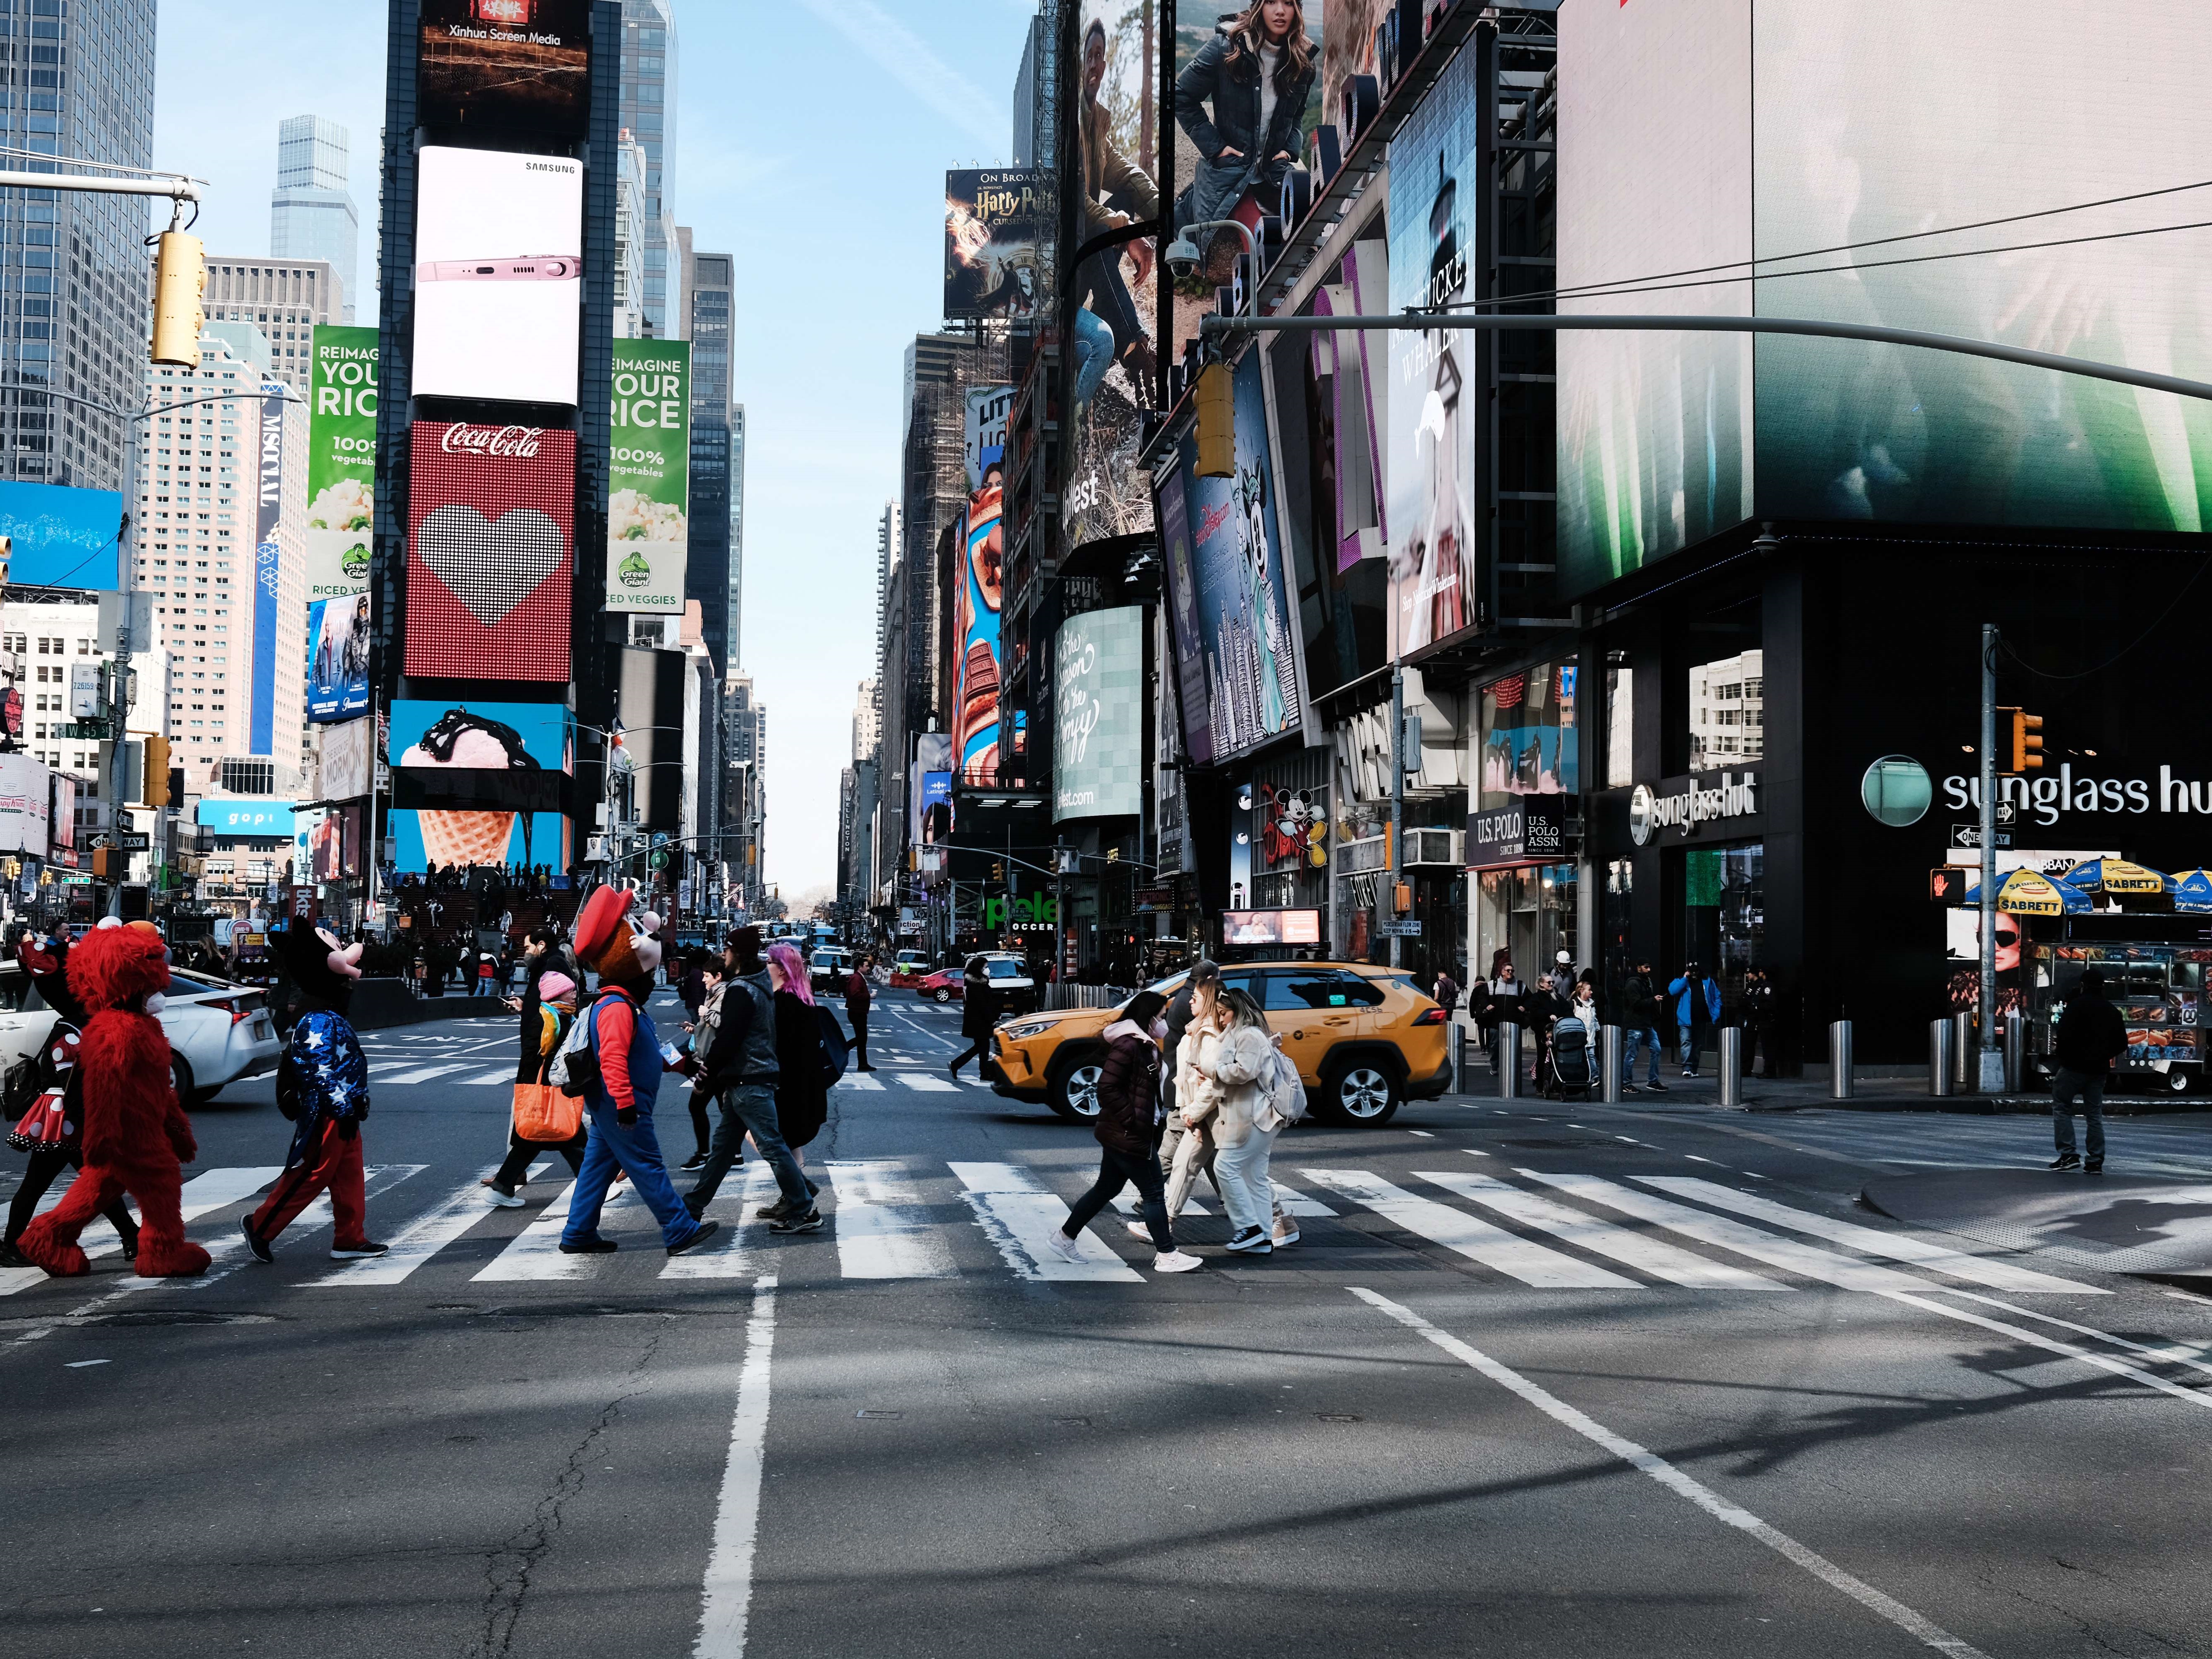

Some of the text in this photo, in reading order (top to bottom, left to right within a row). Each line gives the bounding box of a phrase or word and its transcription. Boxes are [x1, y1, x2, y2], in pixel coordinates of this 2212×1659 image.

[449, 25, 561, 45] Xinhua Screen Media
[526, 162, 575, 174] SAMSUNG
[973, 191, 1020, 220] Harry
[612, 373, 680, 397] OUR
[442, 422, 545, 457] Coca-Cola
[610, 446, 665, 465] 100%
[609, 465, 663, 477] vegetables
[1063, 470, 1098, 536] UpWest
[624, 578, 650, 586] Giant
[313, 585, 348, 595] RICED
[628, 595, 676, 604] VEGGIES
[1403, 595, 1411, 613] Shop
[1066, 631, 1081, 656] the
[1063, 691, 1070, 716] to
[1071, 684, 1086, 710] be
[69, 725, 78, 736] W
[84, 726, 96, 737] 45
[334, 744, 343, 757] BOOK
[343, 739, 348, 751] OF
[1654, 772, 1757, 836] sunglass hut
[1998, 808, 2009, 817] WAY
[1528, 816, 1548, 826] U.S.
[1477, 812, 1521, 844] U.S. POLO
[1528, 826, 1559, 836] POLO
[1528, 837, 1561, 846] ASSN.
[1962, 833, 2007, 843] ONE AY
[1500, 843, 1524, 856] SINCE 1890
[2105, 879, 2159, 889] SABRETT
[295, 888, 312, 918] tkts
[1136, 891, 1172, 903] ELECTRONICS
[2002, 899, 2059, 912] SABRETT
